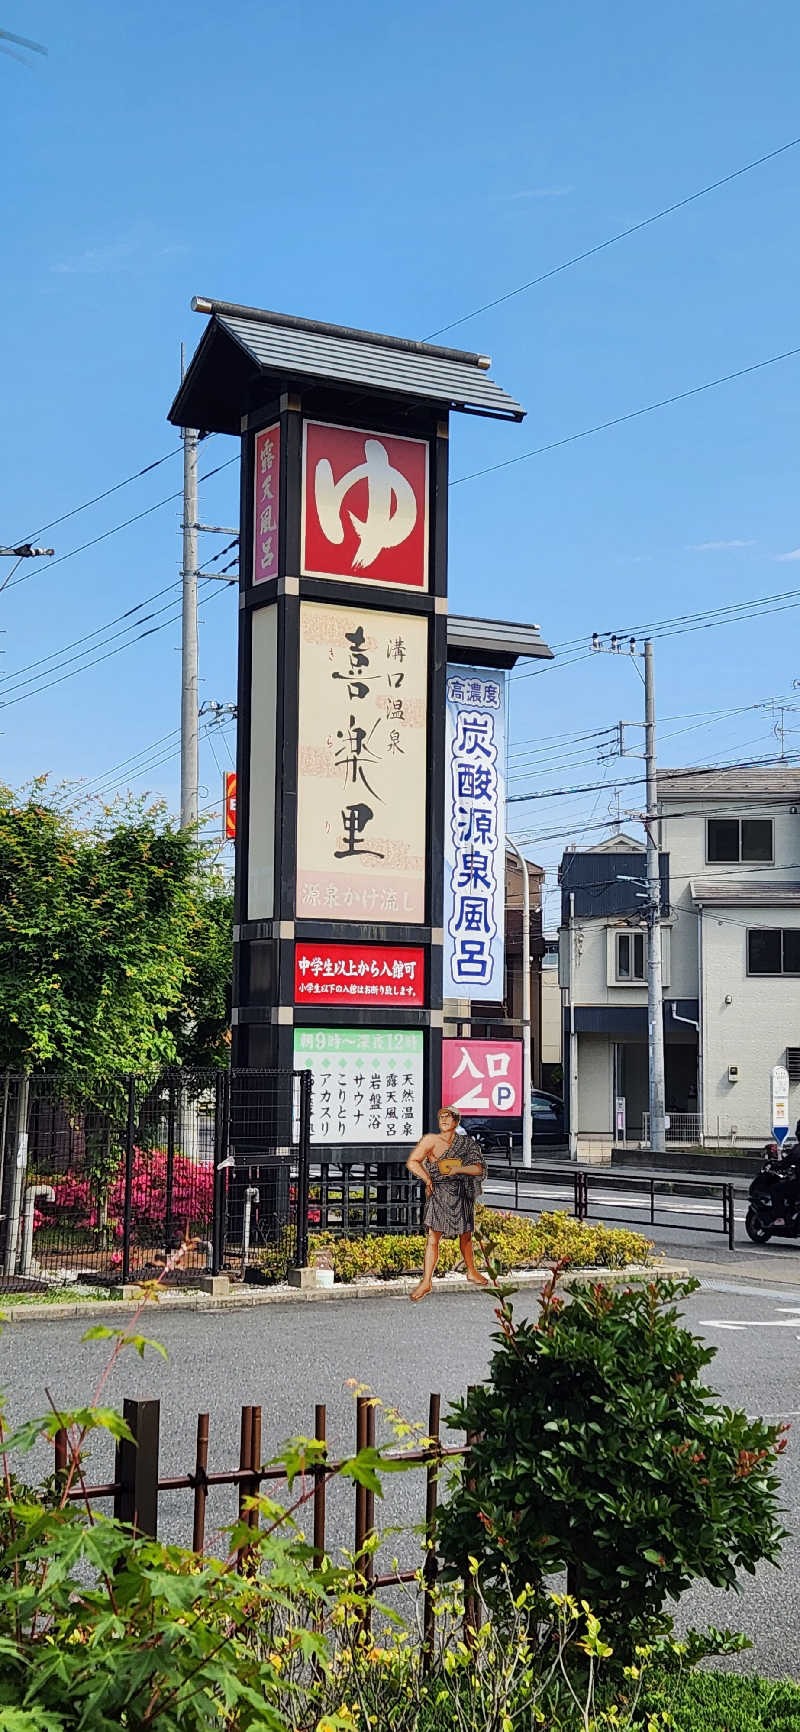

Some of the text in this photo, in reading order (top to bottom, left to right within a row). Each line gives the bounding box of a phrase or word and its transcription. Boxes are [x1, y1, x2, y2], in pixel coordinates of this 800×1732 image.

[259, 438, 276, 569] 露天風呂
[314, 438, 418, 569] ゆ
[386, 637, 405, 754] 溝口温泉
[449, 679, 499, 705] 高濃度
[331, 625, 386, 860] 喜楽里
[454, 717, 493, 977] 炭酸源泉風呂
[302, 882, 415, 914] 源泉かけ流し
[298, 955, 417, 980] 中学生以上から入館可
[452, 1046, 512, 1079] 入口
[320, 1073, 333, 1137] アカスリ
[337, 1073, 347, 1137] こりとり
[353, 1074, 366, 1127] サウナ
[368, 1074, 382, 1130] 岩盤浴
[385, 1073, 399, 1137] 露天風呂
[401, 1073, 416, 1137] 天然温泉
[497, 1086, 511, 1105] P
